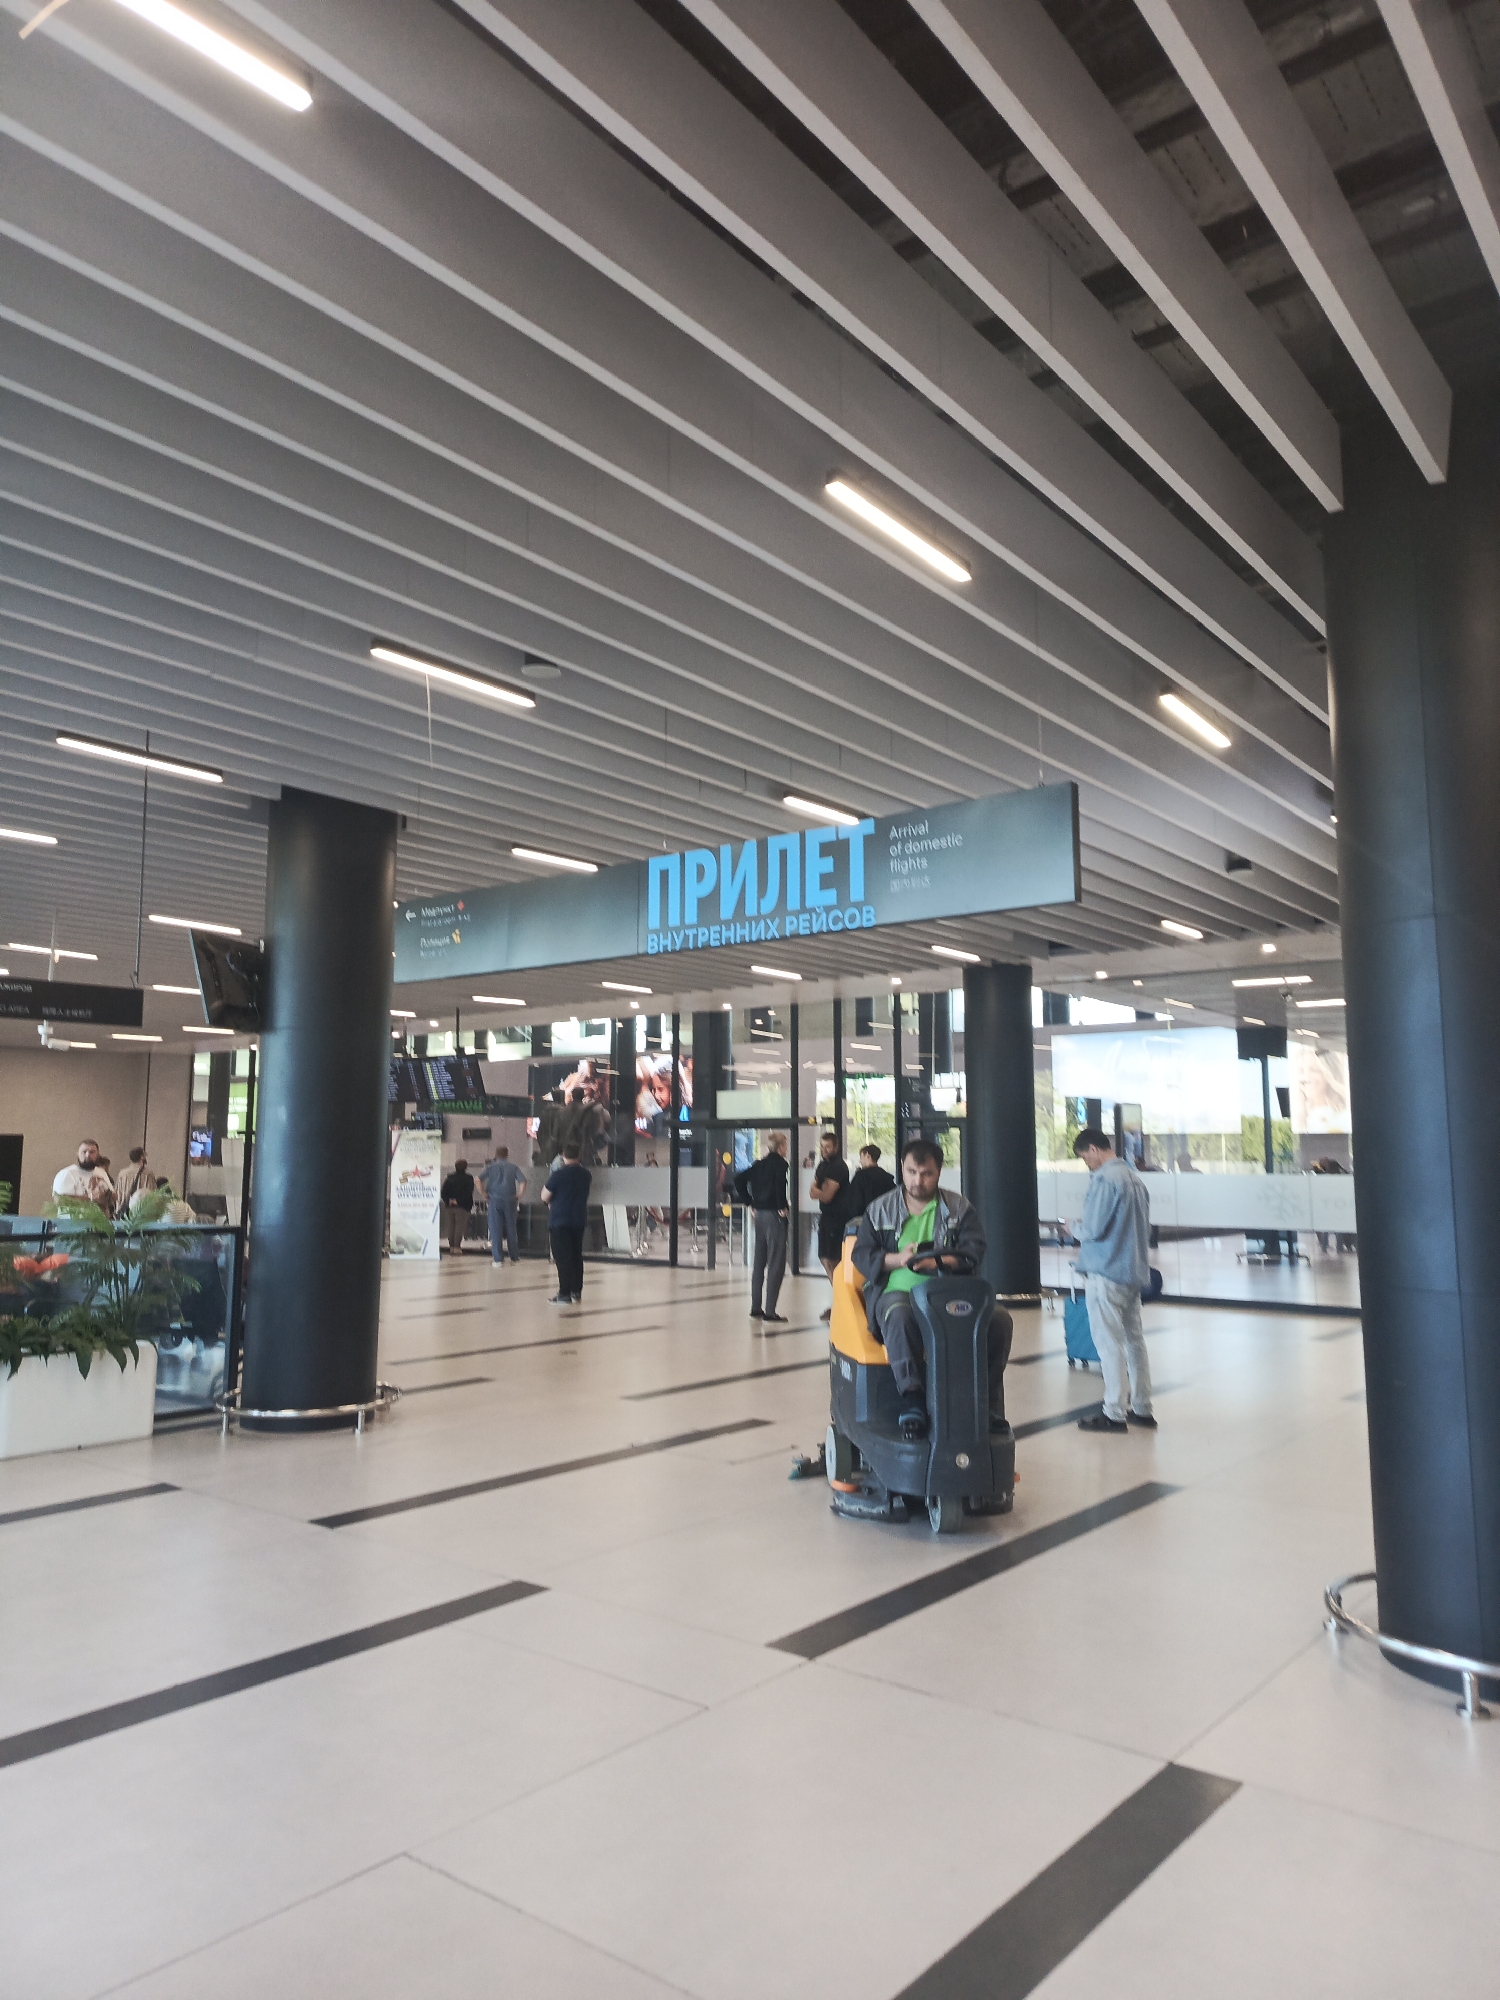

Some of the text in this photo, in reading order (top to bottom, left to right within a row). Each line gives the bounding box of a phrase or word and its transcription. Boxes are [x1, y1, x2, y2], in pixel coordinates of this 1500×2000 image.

[889, 820, 929, 840] Arrival
[889, 832, 964, 856] of domestic
[647, 817, 875, 930] ПРИЛЕТ
[890, 857, 928, 875] flights
[647, 904, 877, 955] ВНУТРЕННИХ РЕЙСОВ
